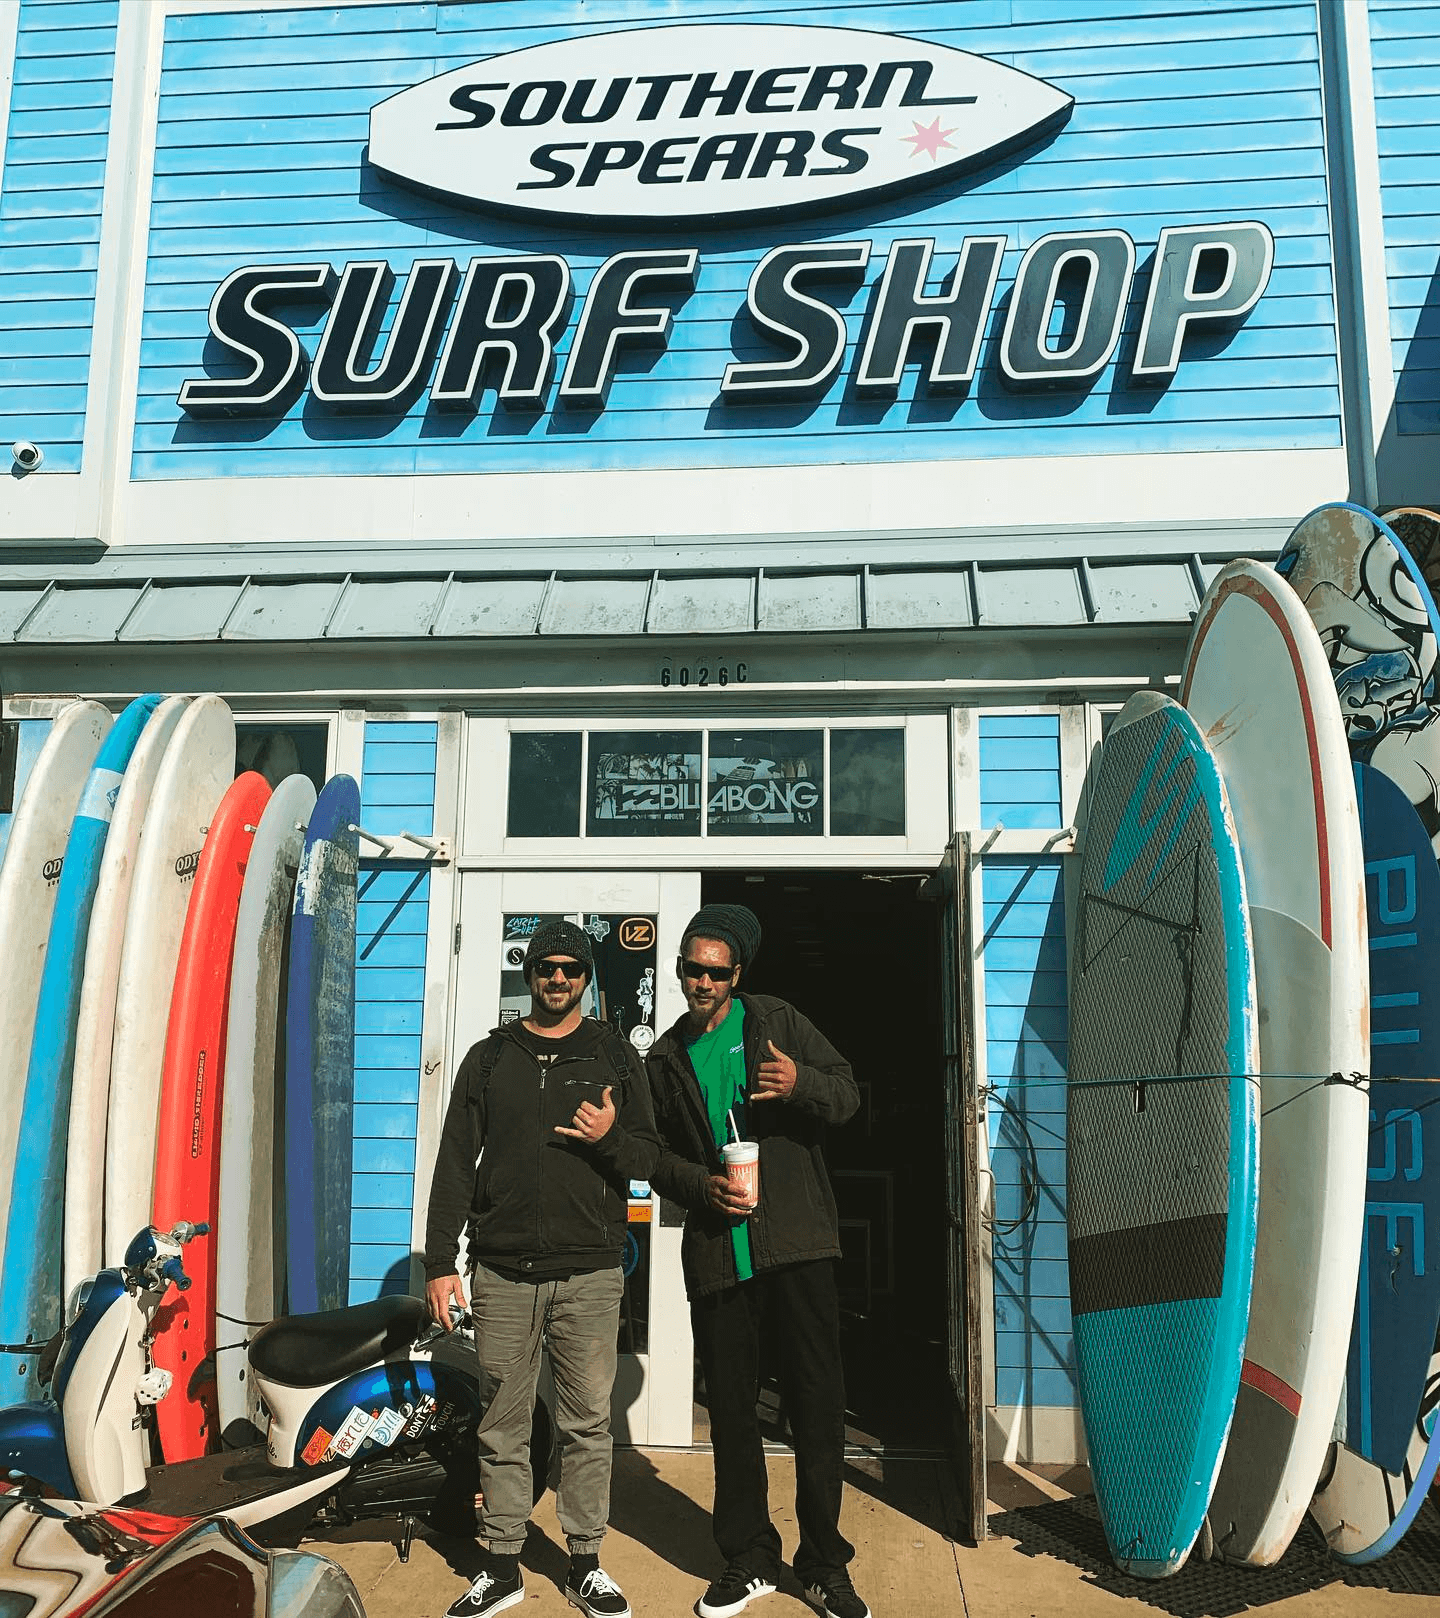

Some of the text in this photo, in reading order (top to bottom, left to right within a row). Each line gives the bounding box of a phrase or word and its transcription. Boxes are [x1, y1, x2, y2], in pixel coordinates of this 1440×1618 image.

[436, 60, 978, 131] SOUTHERN
[516, 127, 881, 190] SPEARS
[177, 220, 1275, 408] SURF SHOP
[661, 662, 747, 687] 6026C
[660, 780, 819, 813] BILLABONG
[43, 857, 64, 880] OD
[175, 851, 201, 876] ODY
